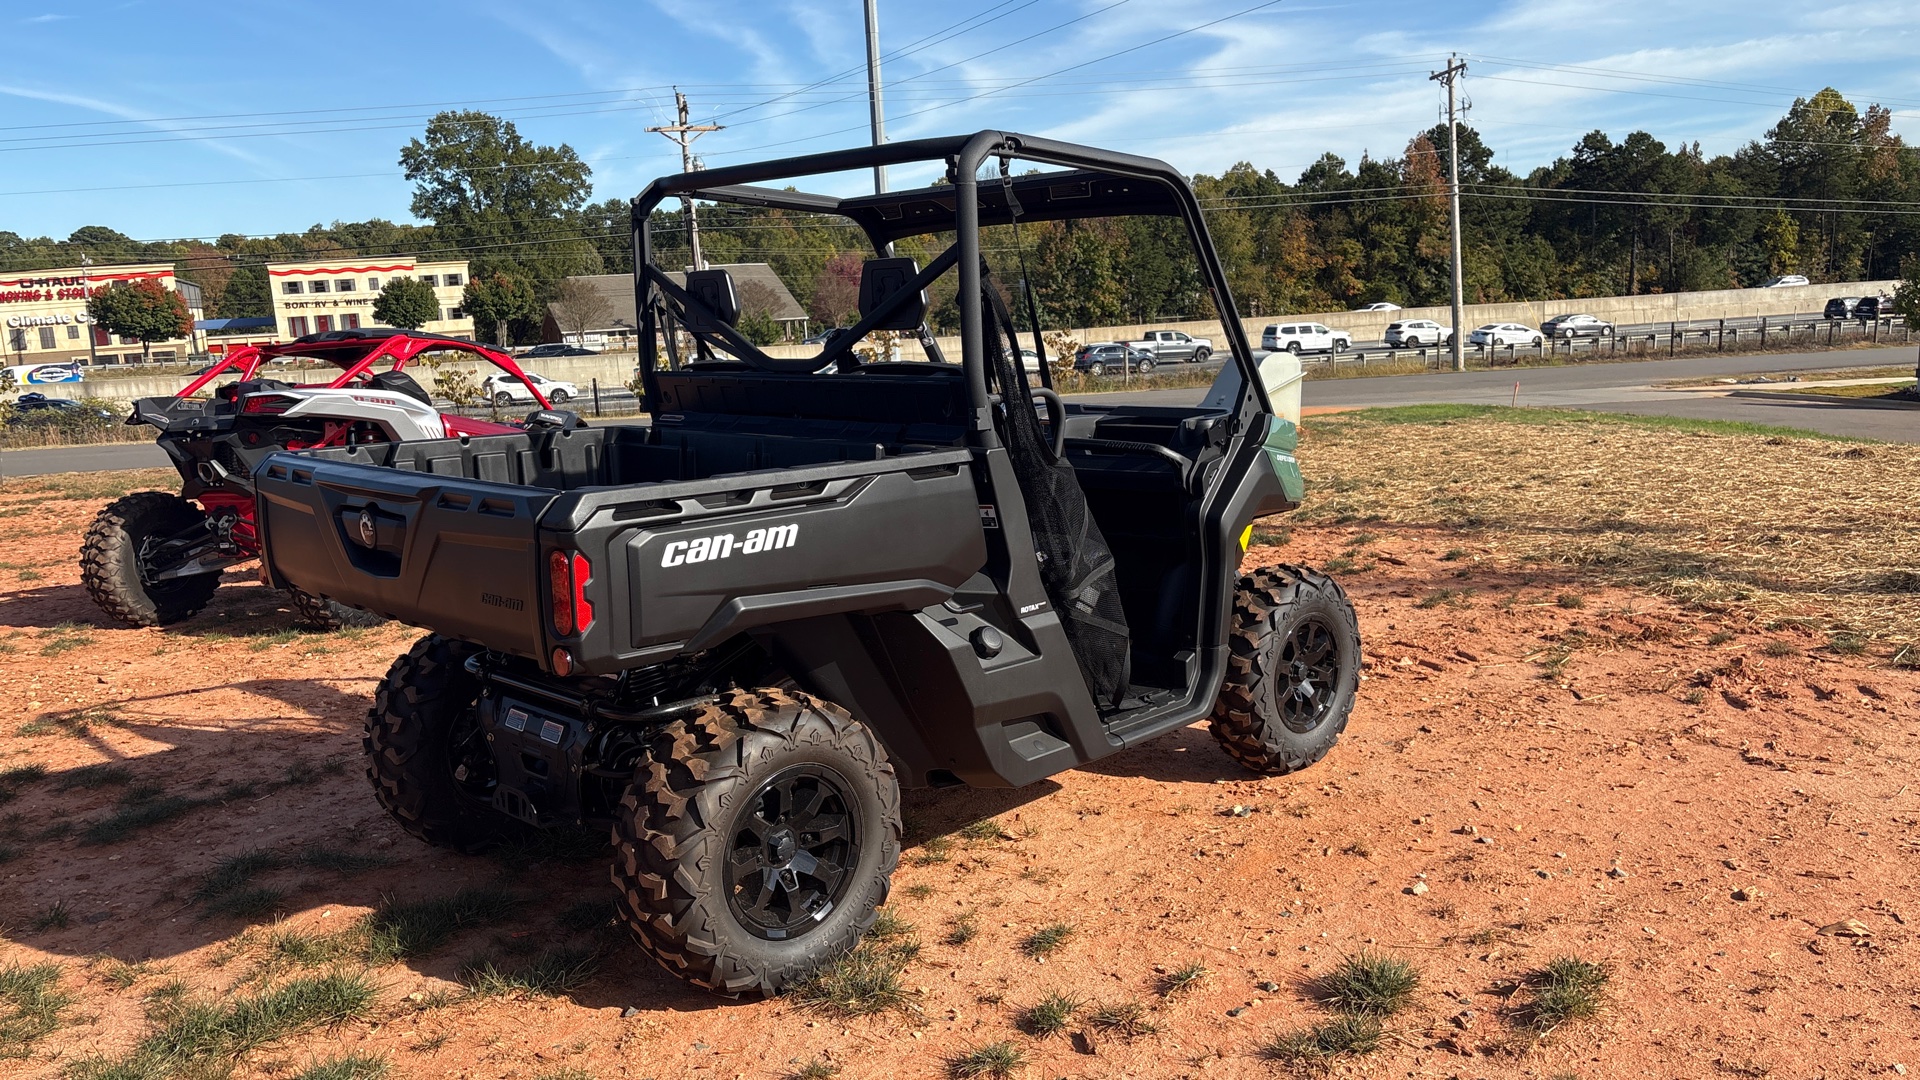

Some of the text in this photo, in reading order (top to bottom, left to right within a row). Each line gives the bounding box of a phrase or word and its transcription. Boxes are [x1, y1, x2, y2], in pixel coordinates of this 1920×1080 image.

[20, 277, 85, 288] U-HAUL
[45, 289, 53, 300] &
[57, 286, 104, 300] STORAG
[284, 301, 308, 309] BOAT
[7, 313, 72, 328] Climate
[353, 395, 396, 405] n-am
[661, 523, 799, 568] can-am
[1020, 603, 1040, 614] ROTAX
